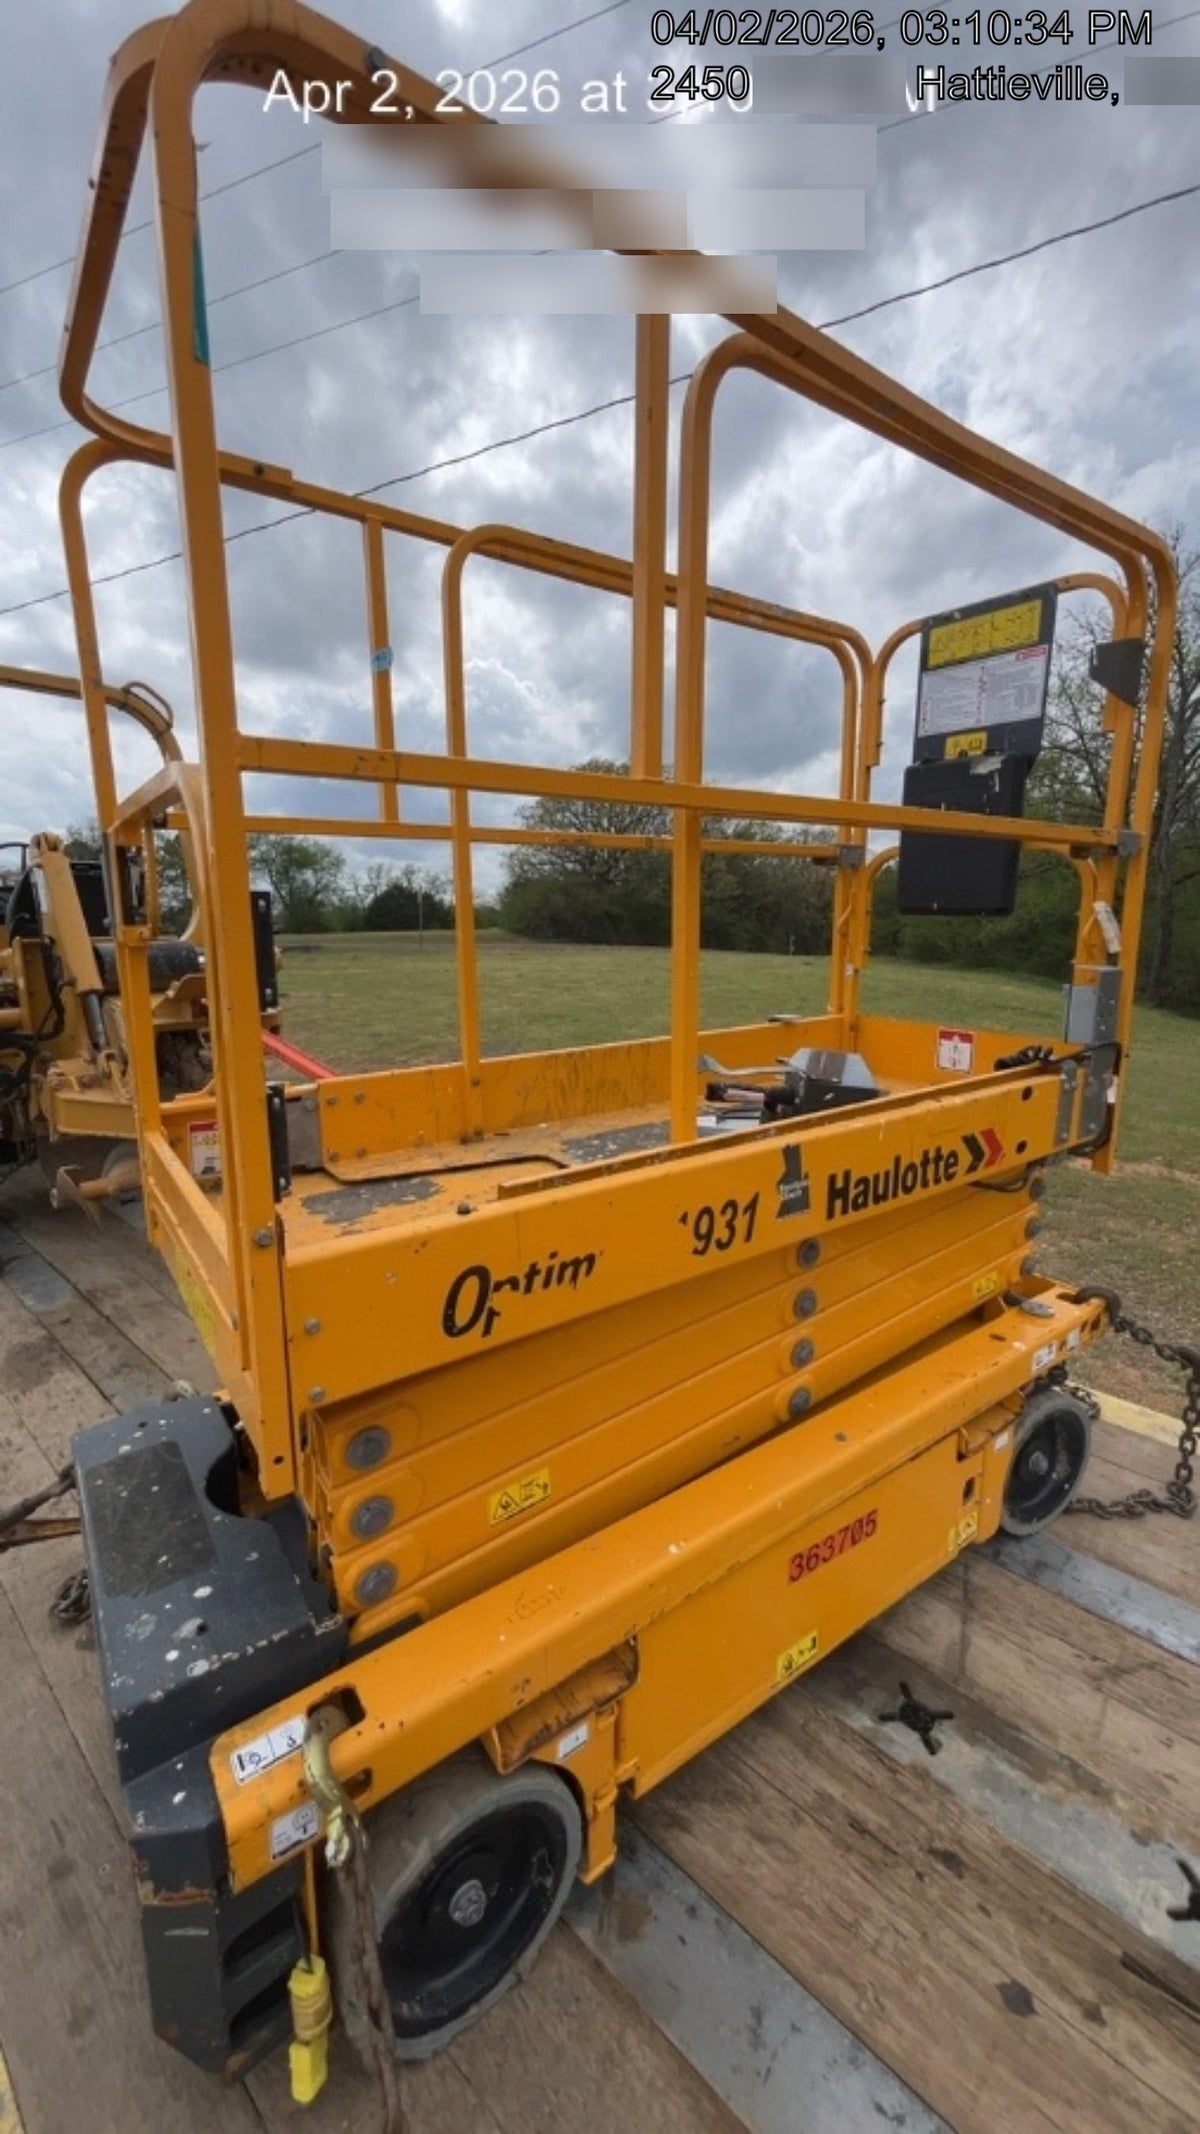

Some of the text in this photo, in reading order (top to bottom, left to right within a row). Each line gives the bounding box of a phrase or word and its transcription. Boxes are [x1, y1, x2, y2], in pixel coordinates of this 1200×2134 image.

[825, 1145, 959, 1220] Haulotte
[442, 1250, 605, 1338] Optim
[788, 1508, 877, 1584] 363705
